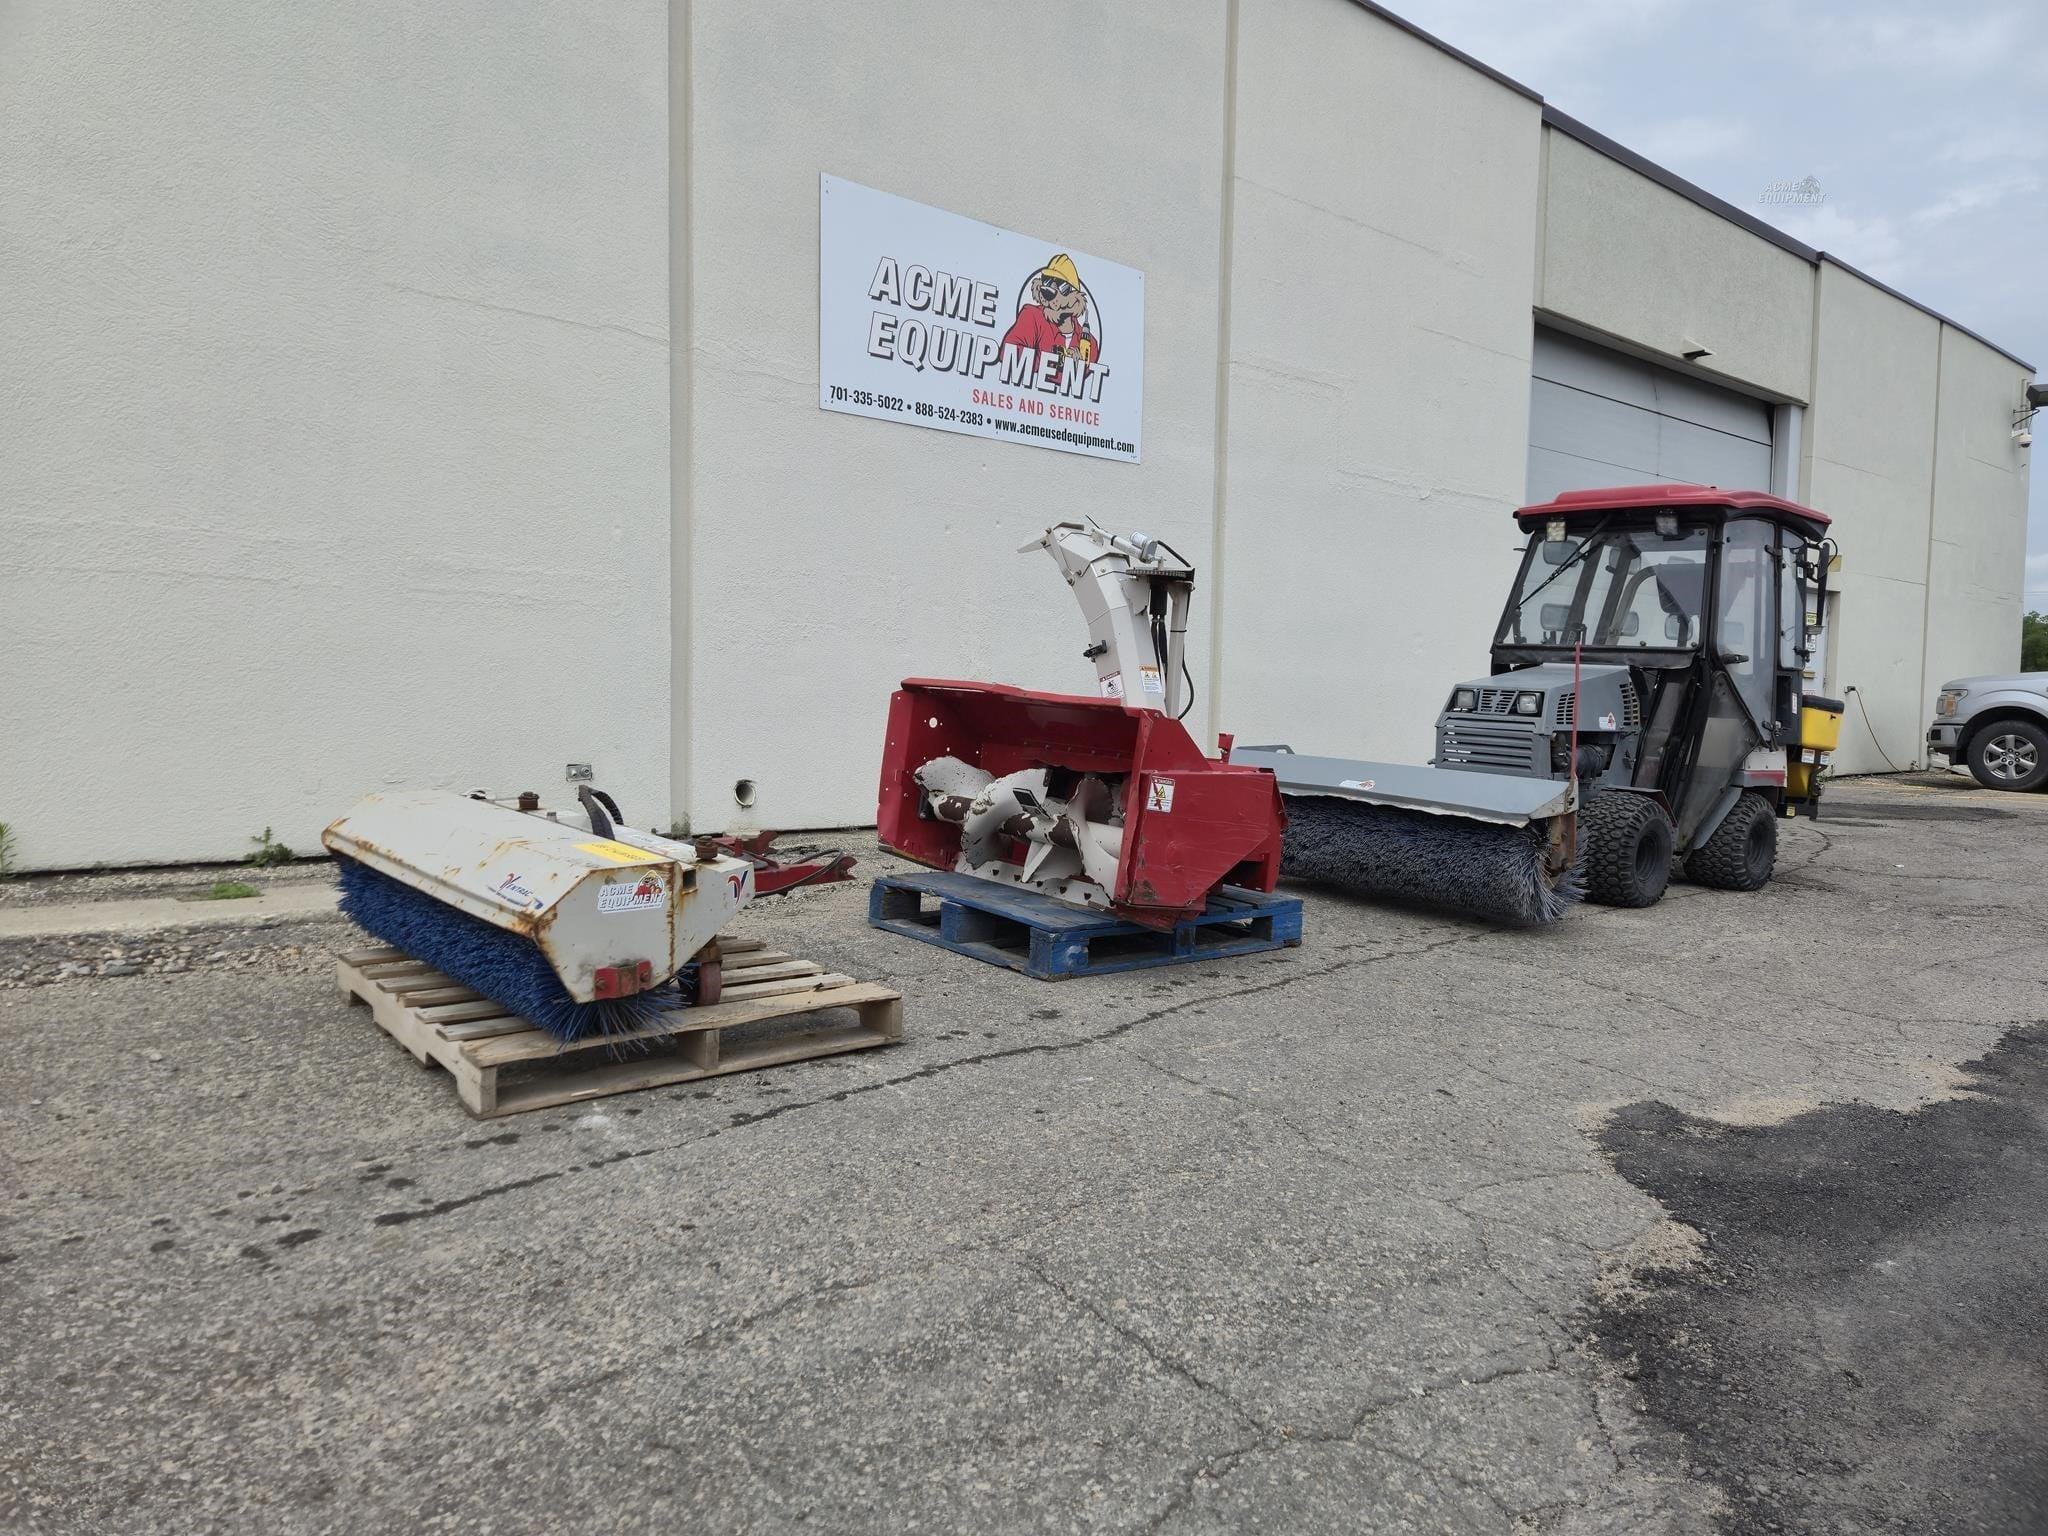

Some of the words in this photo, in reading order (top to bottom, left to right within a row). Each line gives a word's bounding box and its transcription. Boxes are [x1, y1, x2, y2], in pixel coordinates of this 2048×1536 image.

[868, 256, 999, 328] ACME
[867, 311, 1110, 403] EQUIPMENT
[830, 385, 904, 412] 701-335-5022
[915, 402, 984, 427] 888-524-2383
[995, 417, 1135, 454] www.acmeusedequipment.com
[972, 388, 1013, 410] SALES
[1019, 396, 1044, 416] AND
[1049, 403, 1100, 426] SERVICE
[599, 893, 666, 909] EQUIPMENT
[600, 885, 634, 897] ACME
